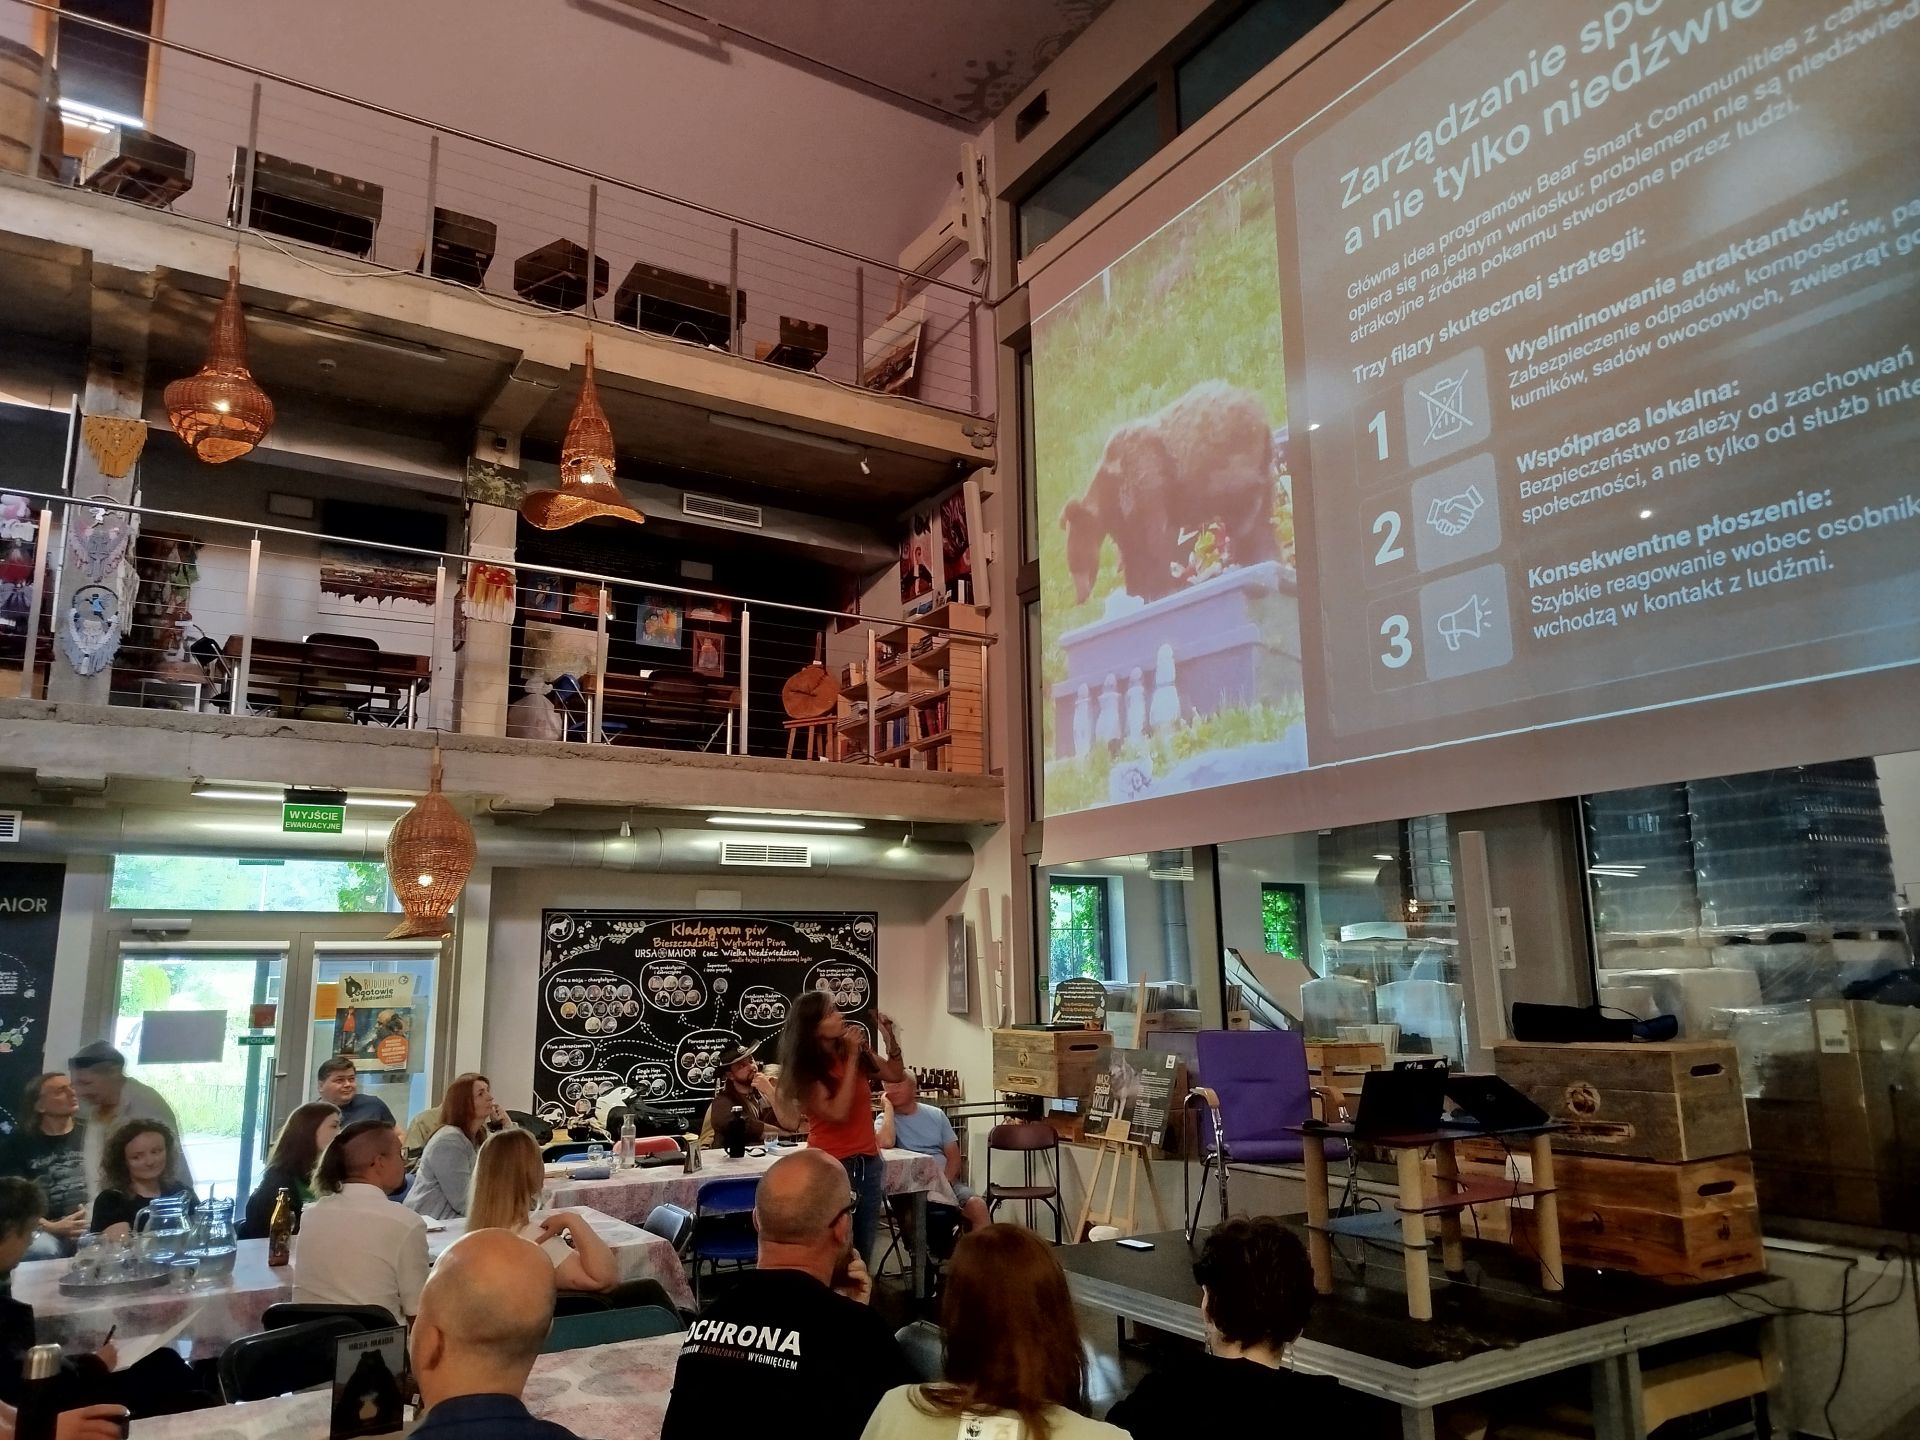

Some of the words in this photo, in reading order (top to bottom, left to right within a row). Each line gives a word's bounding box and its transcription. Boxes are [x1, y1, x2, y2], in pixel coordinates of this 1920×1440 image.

[1340, 44, 1566, 209] Zarządzanie
[1347, 262, 1400, 300] Główna
[1403, 241, 1435, 269] idea
[1439, 186, 1532, 252] programów
[1537, 159, 1578, 194] Bear
[1583, 121, 1644, 166] Smart
[1648, 37, 1798, 130] Communities
[1804, 24, 1817, 45] z
[1344, 224, 1363, 255] a
[1372, 189, 1424, 239] nie
[1433, 123, 1530, 203] tylko
[1349, 289, 1392, 321] opiera
[1396, 275, 1417, 296] się
[1420, 263, 1439, 283] na
[1443, 228, 1502, 274] jednym
[1507, 183, 1585, 235] wniosku:
[1590, 116, 1707, 195] problemem
[1713, 93, 1748, 124] nie
[1754, 76, 1783, 100] są
[1350, 295, 1424, 343] atrakcyjne
[1428, 266, 1476, 302] źródła
[1481, 224, 1557, 278] pokarmu
[1562, 168, 1664, 231] stworzone
[1670, 131, 1731, 180] przez
[1736, 93, 1801, 140] ludzi.
[1352, 357, 1387, 385] Trzy
[1391, 332, 1435, 366] filary
[1438, 274, 1543, 343] skutecznej
[1547, 226, 1647, 289] strategii:
[1505, 277, 1676, 364] Wyeliminowanie
[1681, 198, 1849, 286] atraktantów:
[1508, 321, 1640, 389] Zabezpieczenie
[1645, 278, 1741, 329] odpadów,
[1745, 216, 1886, 286] kompostów,
[1510, 369, 1589, 411] kurników,
[1592, 340, 1651, 377] sadów
[1657, 287, 1784, 349] owocowych,
[1789, 240, 1890, 296] zwierząt
[1368, 410, 1389, 461] 1
[1516, 415, 1641, 474] Współpraca
[1645, 379, 1740, 427] lokalna:
[1520, 435, 1670, 499] Bezpieczeństwo
[1675, 410, 1742, 446] zależy
[1748, 391, 1779, 419] od
[1784, 344, 1914, 408] zachowań
[1522, 468, 1648, 524] społeczności,
[1651, 464, 1665, 481] a
[1669, 452, 1701, 476] nie
[1705, 433, 1760, 465] tylko
[1765, 415, 1796, 443] od
[1802, 395, 1870, 431] służb
[1373, 510, 1404, 566] 2
[1528, 529, 1692, 589] Konsekwentne
[1696, 488, 1833, 546] płoszenie:
[1531, 582, 1601, 614] Szybkie
[1606, 549, 1727, 595] reagowanie
[1731, 528, 1811, 562] wobec
[1380, 614, 1412, 668] 3
[1533, 607, 1618, 640] wchodzą
[1621, 601, 1639, 619] w
[1644, 576, 1724, 613] kontakt
[1729, 575, 1743, 594] z
[1746, 549, 1835, 589] ludźmi.
[285, 821, 341, 830] EWAKUACYJNE
[290, 810, 339, 821] WYJŚCIE
[634, 948, 658, 958] URSA
[667, 948, 697, 958] MAIOR
[721, 948, 747, 957] Wielka
[652, 937, 719, 949] Bieszczadzkiej
[766, 937, 787, 947] Piwa
[671, 921, 742, 940] Kladogram
[745, 925, 769, 939] piw
[685, 1319, 801, 1356] OCHRONA
[748, 1351, 798, 1370] WYGINIĘCIEM
